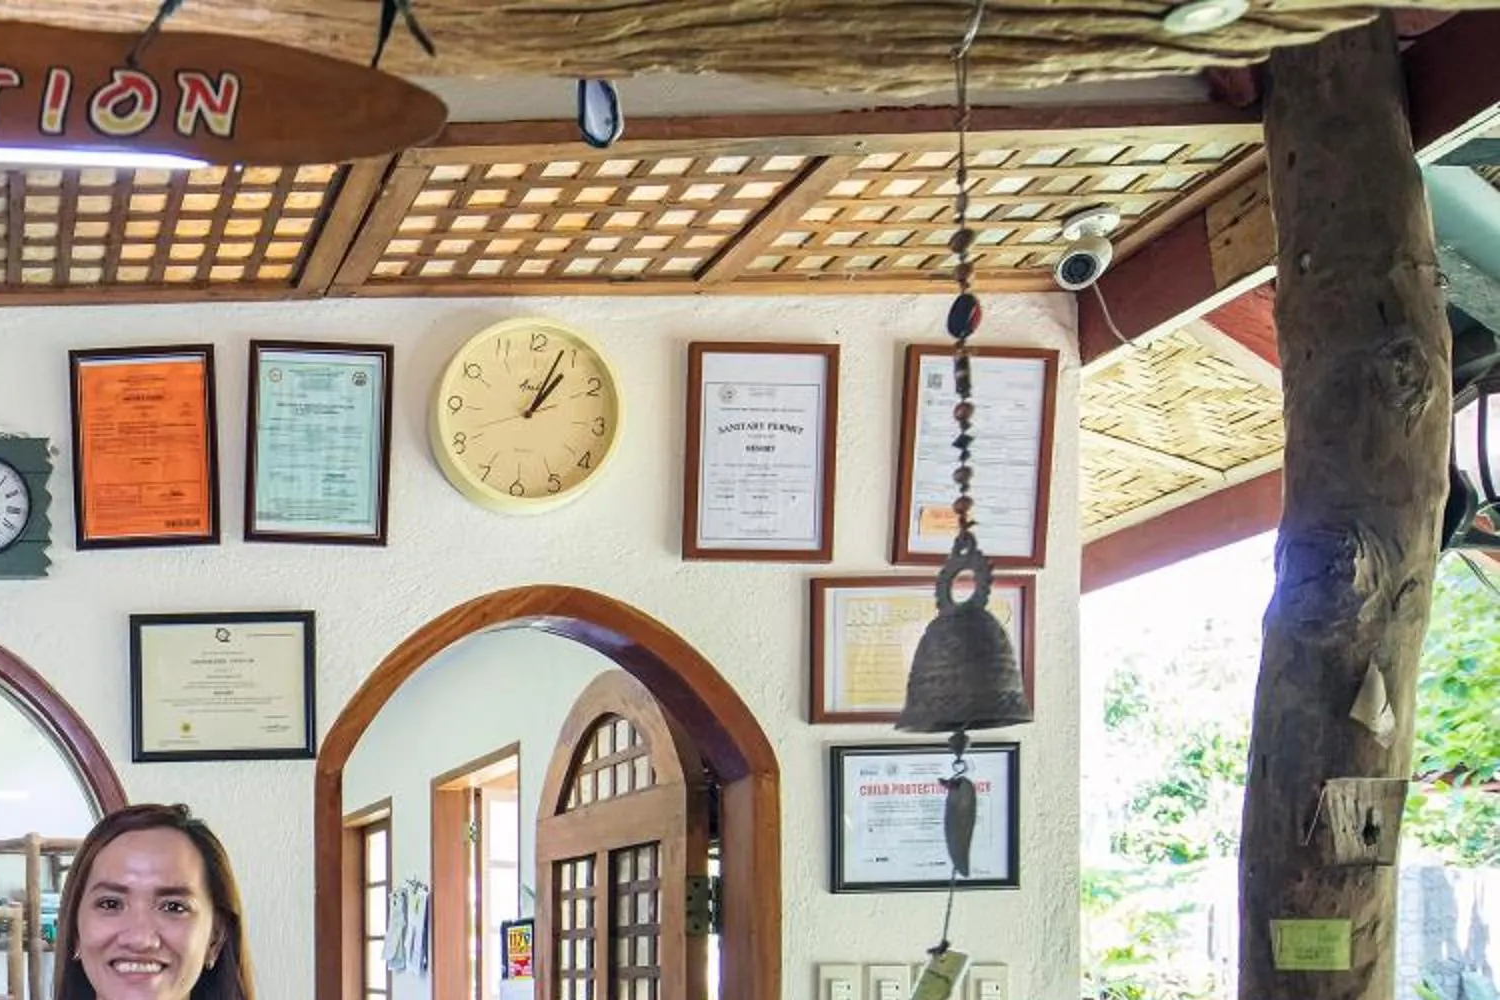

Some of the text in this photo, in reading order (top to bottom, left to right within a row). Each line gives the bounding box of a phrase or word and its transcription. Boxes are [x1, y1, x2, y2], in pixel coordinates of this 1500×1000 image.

[495, 338, 511, 357] 11
[529, 333, 548, 352] 12
[586, 377, 602, 396] 2
[447, 395, 463, 415] 9
[591, 416, 606, 437] 3
[452, 432, 467, 454] 8
[577, 451, 591, 469] 4
[478, 464, 491, 482] 7
[509, 479, 525, 497] 6
[547, 473, 562, 493] 5
